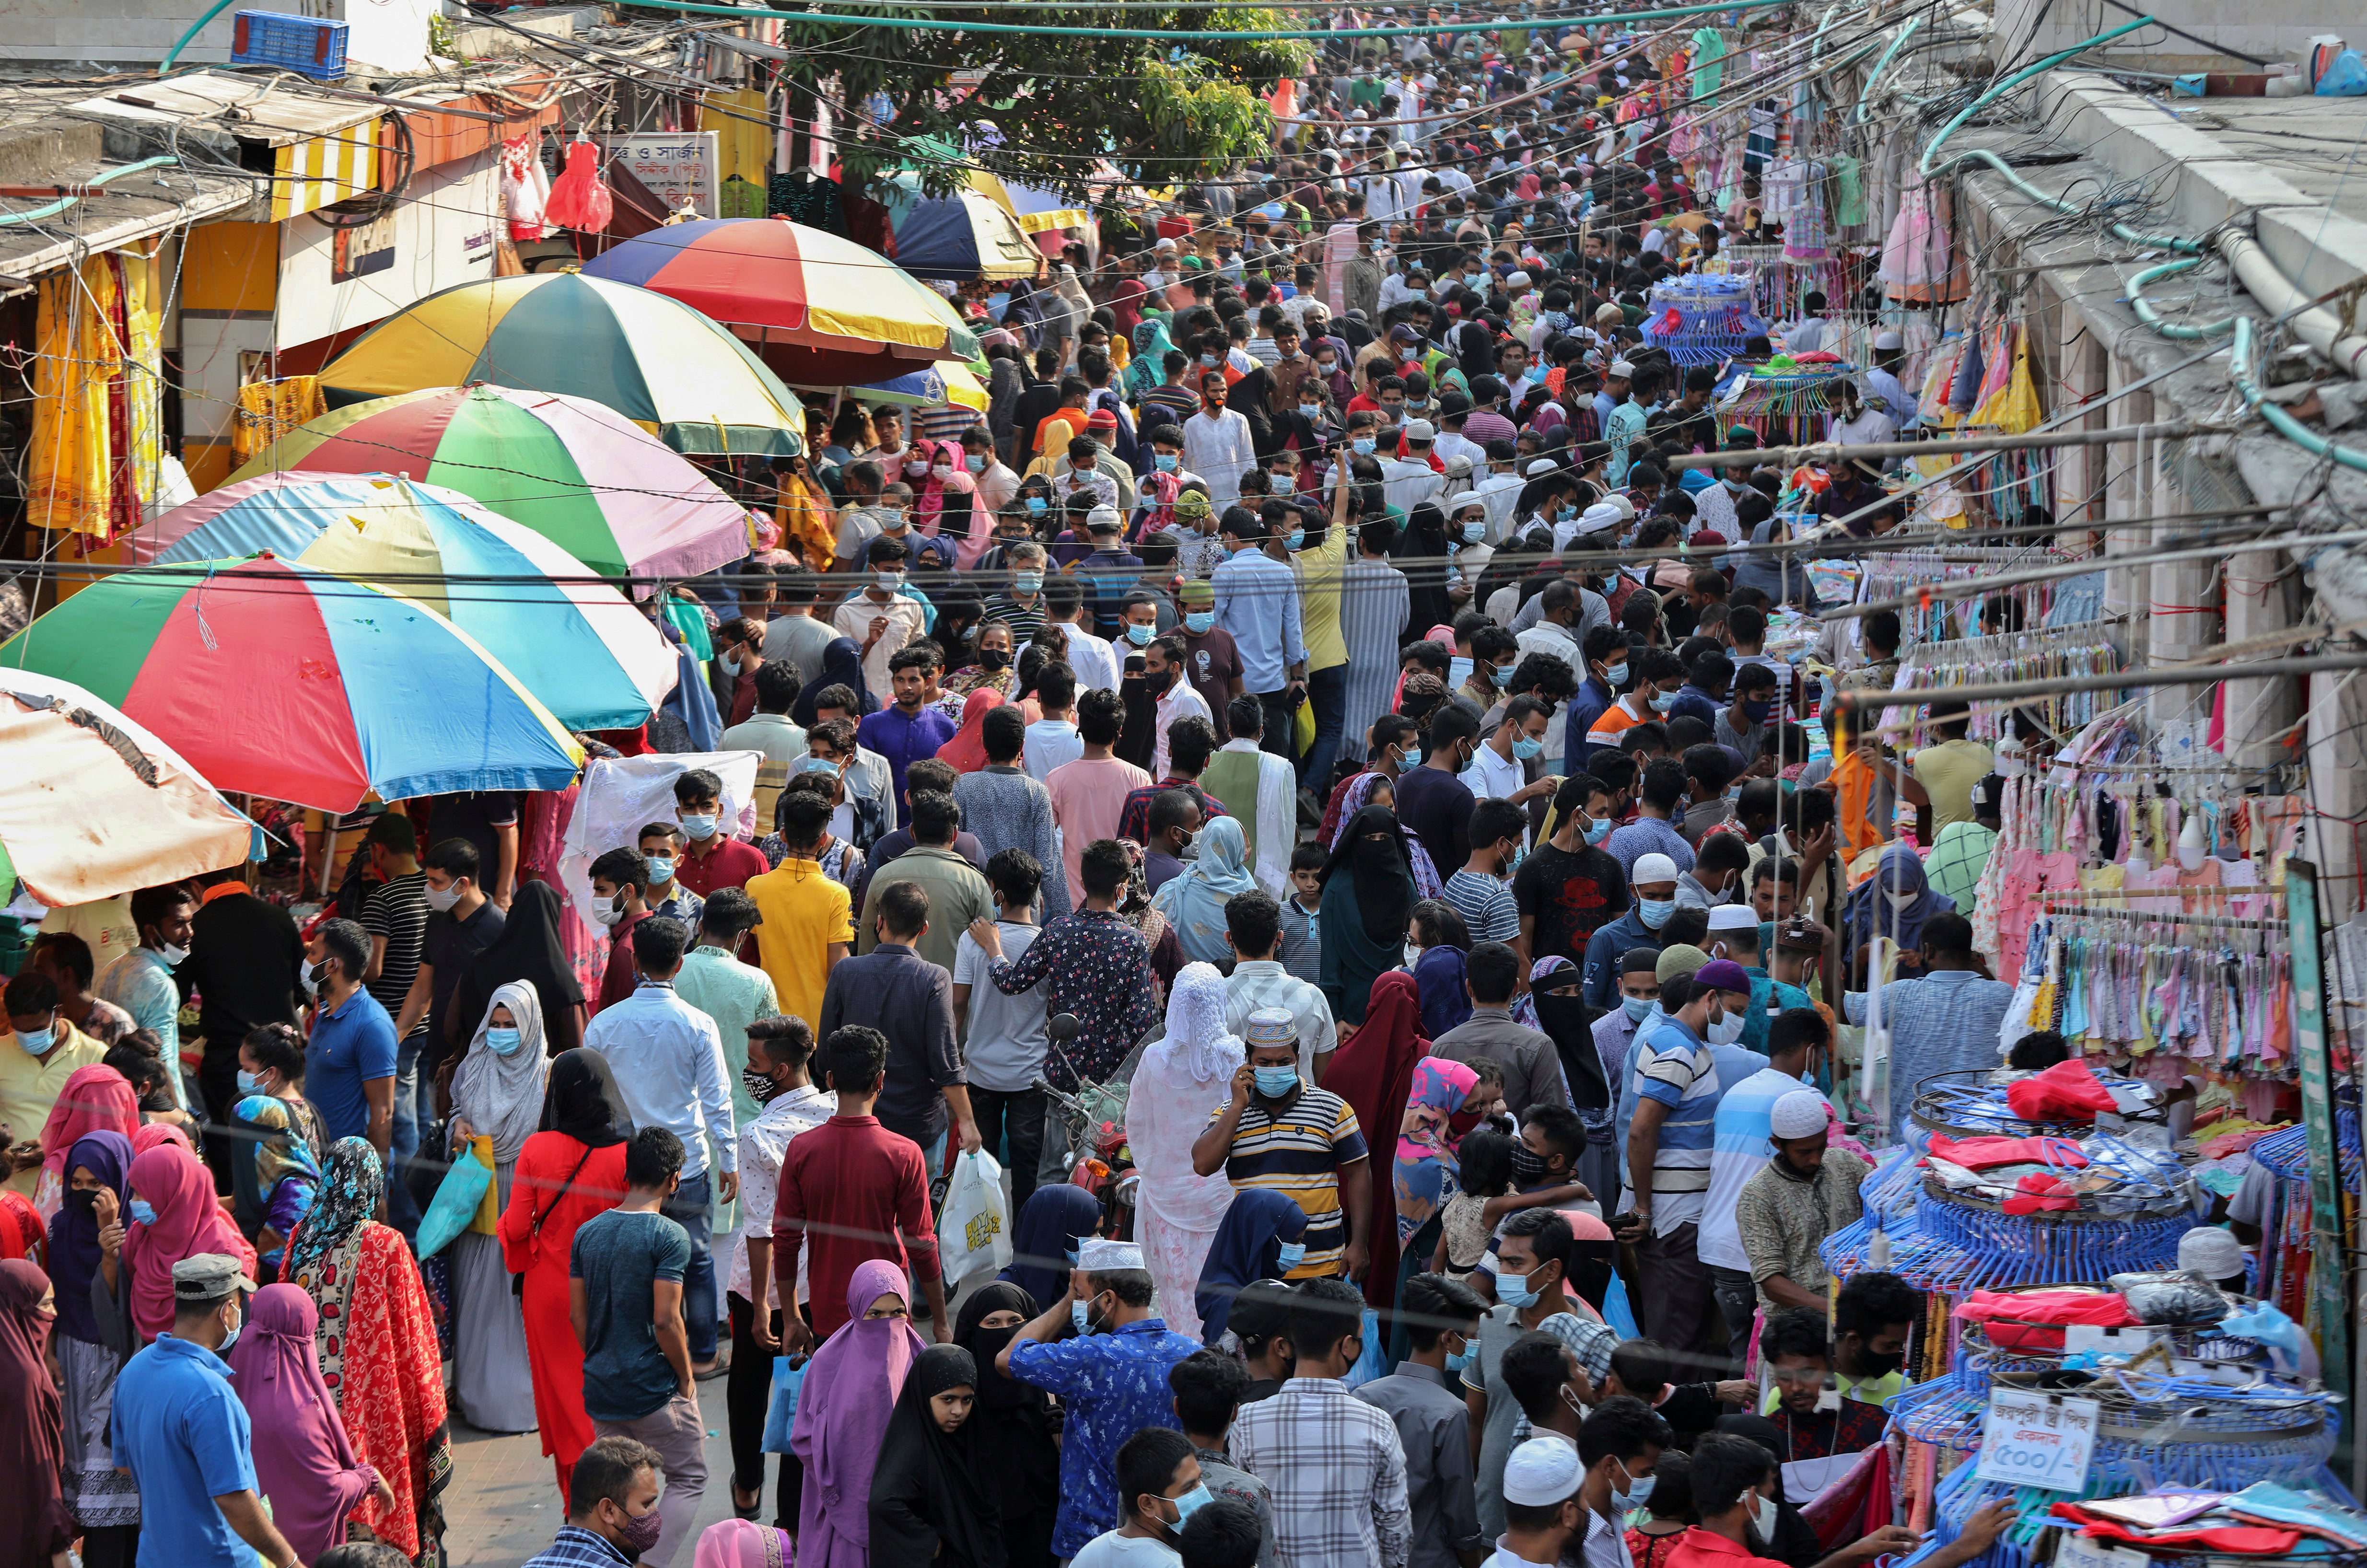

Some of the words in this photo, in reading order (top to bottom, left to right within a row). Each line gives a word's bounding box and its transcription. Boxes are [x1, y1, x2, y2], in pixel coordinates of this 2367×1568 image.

[655, 141, 706, 160] সার্জন
[1198, 652, 1207, 661] K
[965, 1209, 988, 1240] BUY
[967, 1226, 986, 1252] GET
[2013, 1429, 2063, 1446] একদাম
[1994, 1444, 2075, 1476] ৫০০/-
